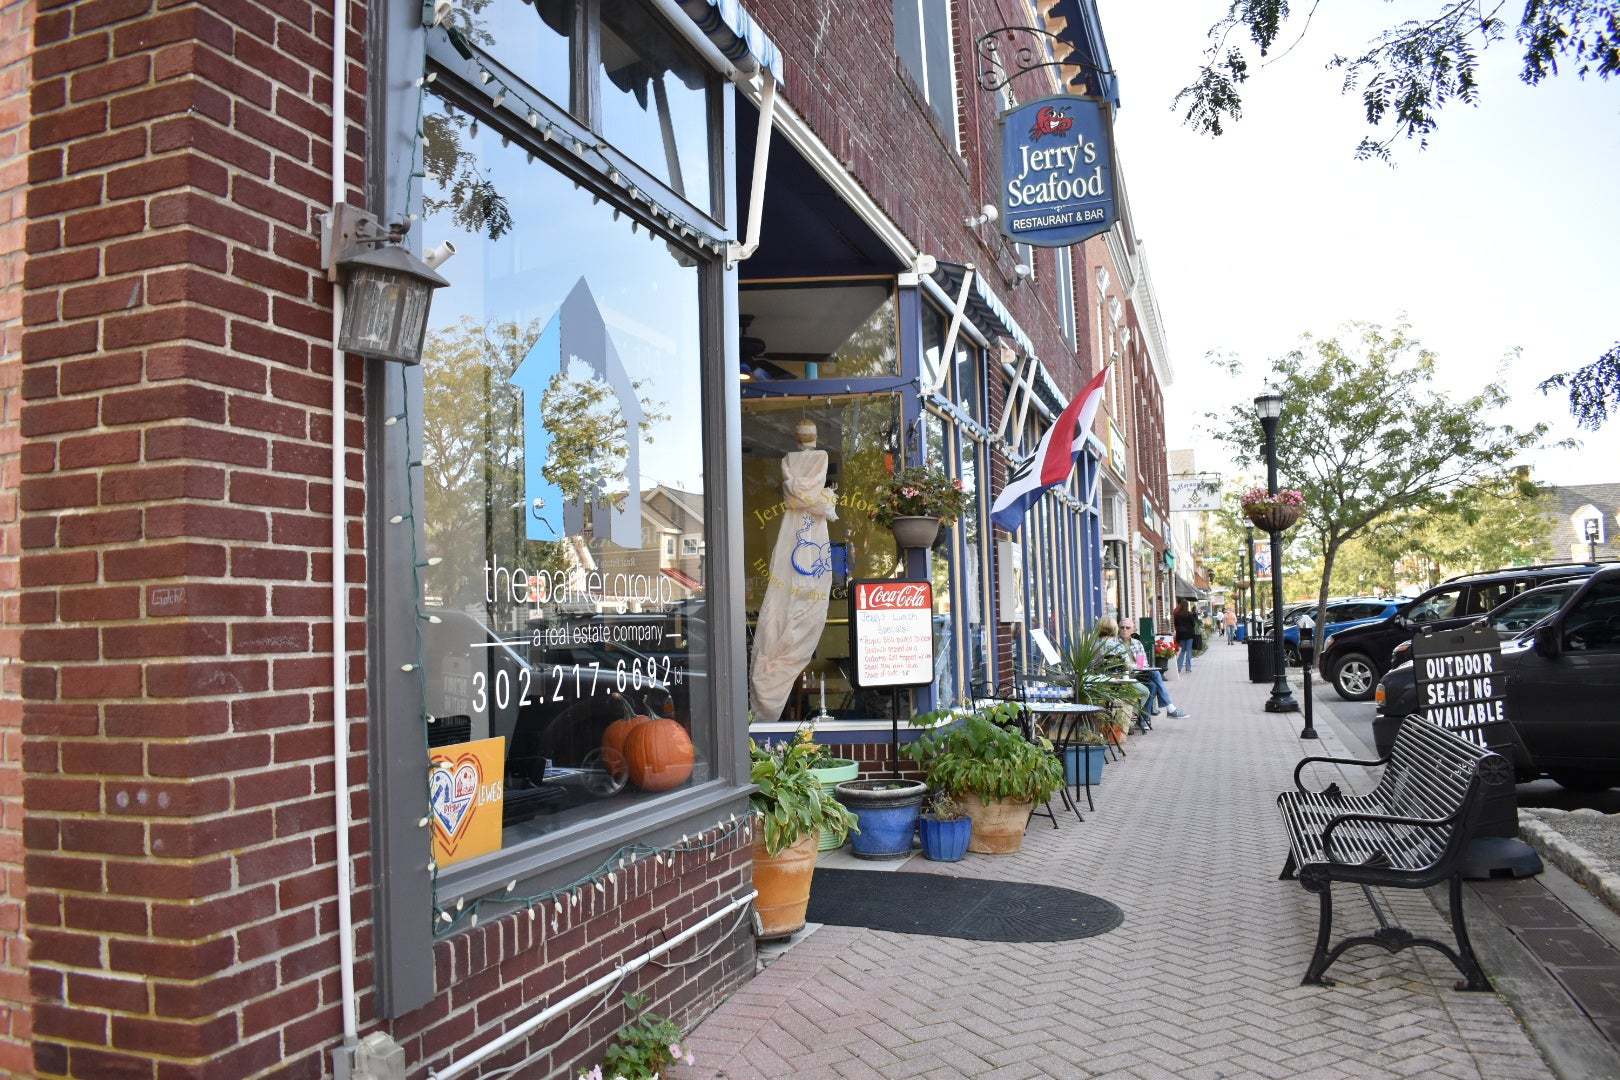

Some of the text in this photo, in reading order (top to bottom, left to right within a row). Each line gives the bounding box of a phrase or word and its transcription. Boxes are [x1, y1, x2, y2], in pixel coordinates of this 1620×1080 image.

[1018, 134, 1096, 180] Jerry's
[1008, 167, 1104, 208] Seafood
[1013, 208, 1104, 230] RESTAURANT & BAR
[820, 488, 880, 513] Seafoo
[484, 553, 672, 614] the parker group
[869, 585, 928, 608] Coca-Cola
[533, 622, 664, 647] a real estate company
[1426, 653, 1493, 679] OUTDOOR
[472, 656, 671, 713] 302.217.6692
[1427, 677, 1492, 704] SEATING
[1426, 700, 1504, 728] AVAILABLE
[478, 781, 502, 806] LEWES
